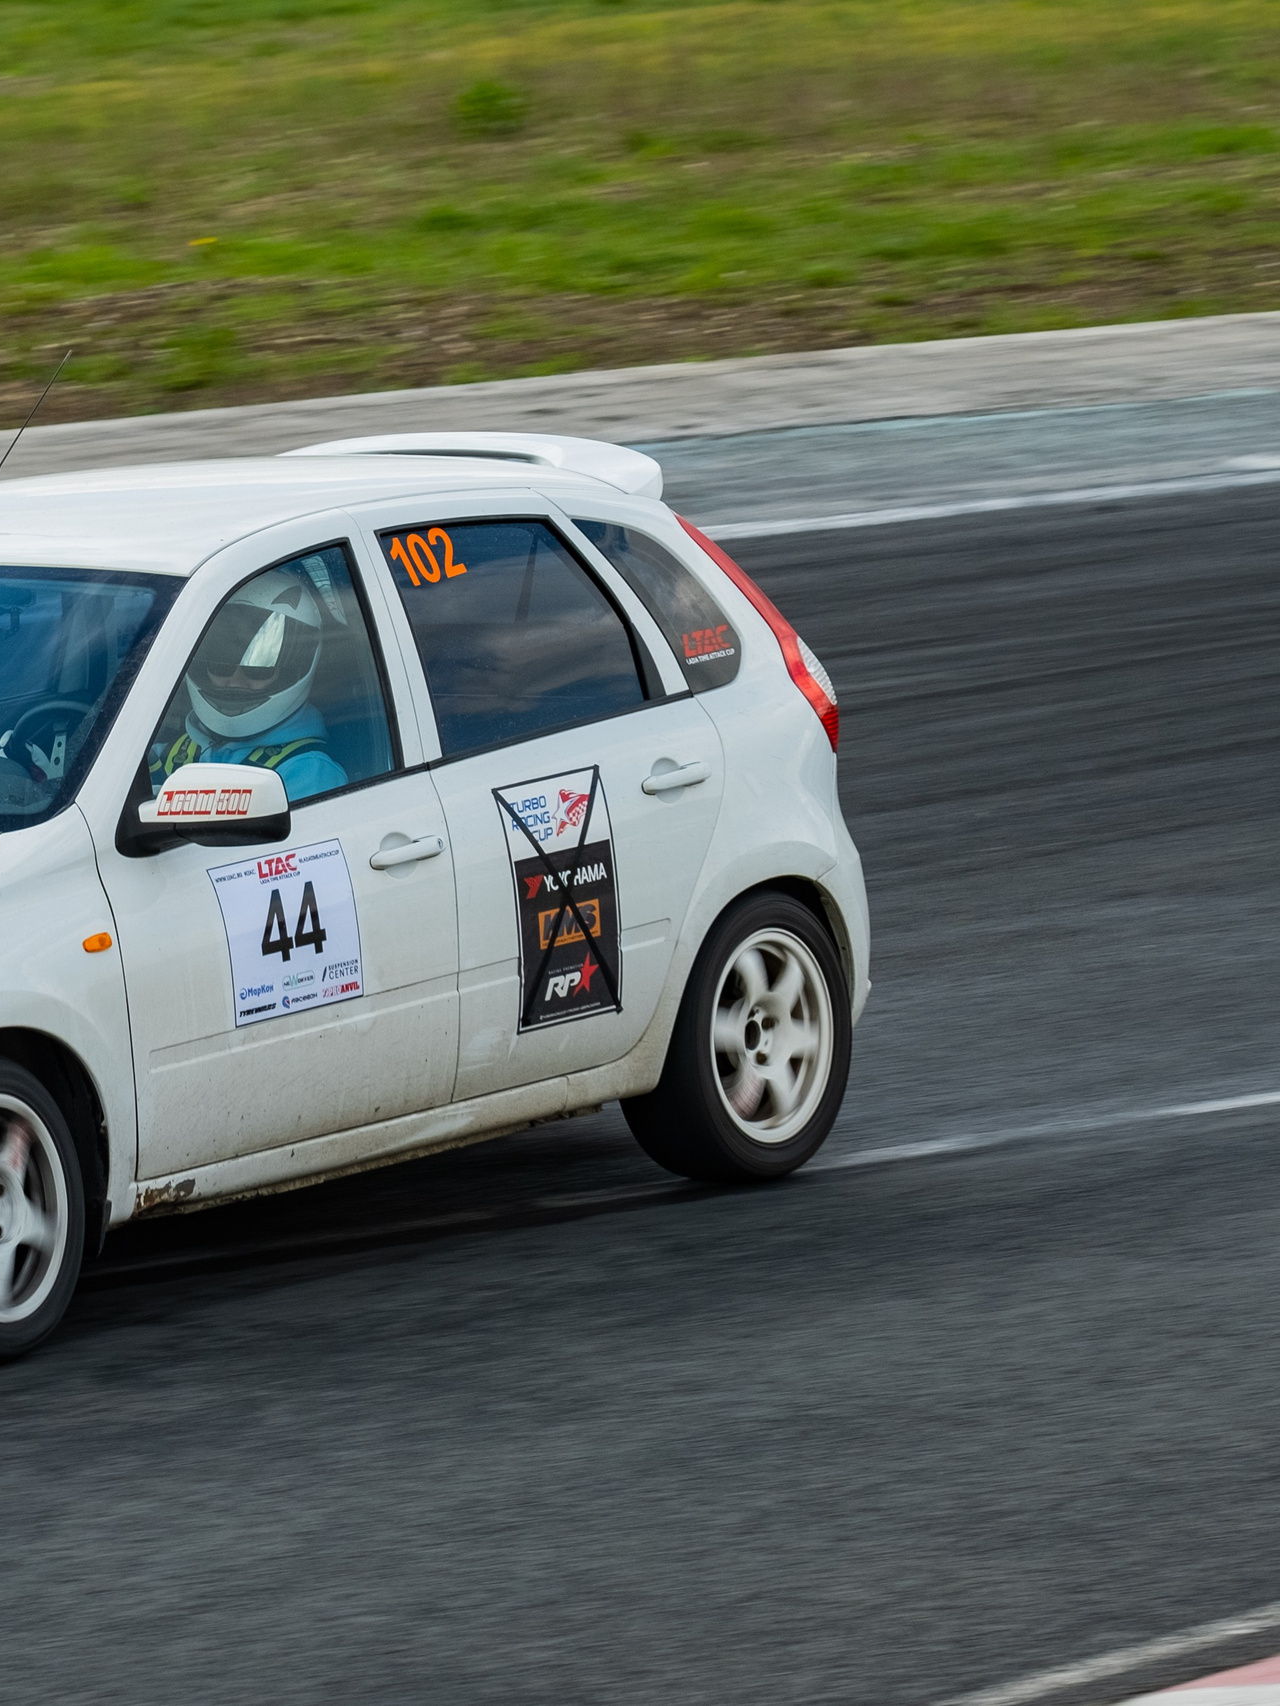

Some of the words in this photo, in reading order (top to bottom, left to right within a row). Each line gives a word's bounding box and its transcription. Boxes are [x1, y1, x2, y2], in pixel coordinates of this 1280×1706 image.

[390, 527, 468, 587] 102
[682, 624, 732, 658] LTAC
[511, 811, 551, 831] RCING
[257, 853, 298, 879] LTAC
[261, 881, 327, 962] 44
[328, 959, 359, 971] SUSPENSION
[328, 965, 359, 981] CENTER
